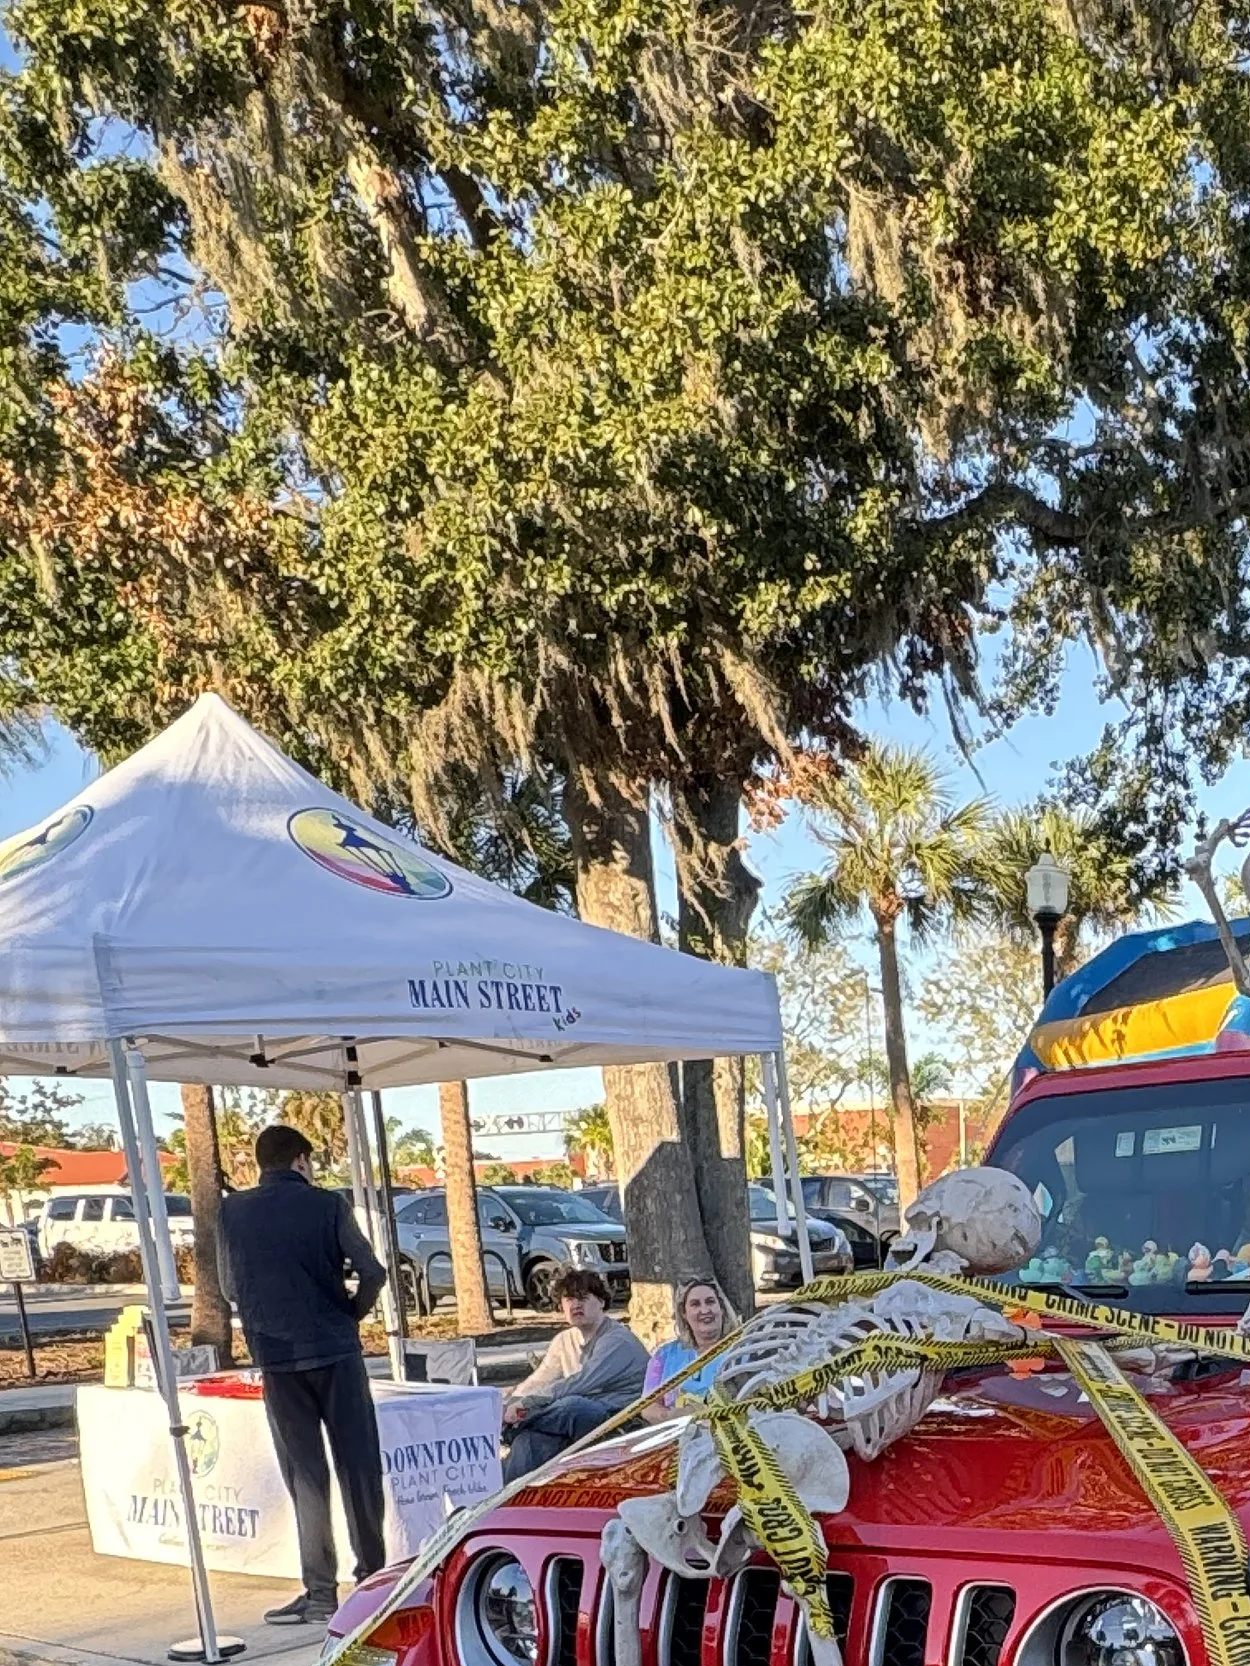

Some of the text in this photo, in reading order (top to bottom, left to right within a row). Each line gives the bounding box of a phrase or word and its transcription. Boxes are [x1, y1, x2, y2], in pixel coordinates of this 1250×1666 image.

[433, 960, 544, 980] PLANT CITY
[408, 979, 563, 1013] MAIN STREET
[1104, 1306, 1160, 1335] SCENE
[1177, 1322, 1199, 1343] DO
[1204, 1328, 1236, 1350] NOT
[391, 1462, 488, 1489] PLANT CITY
[204, 1484, 245, 1503] CITY
[199, 1503, 260, 1538] TREET
[1188, 1522, 1247, 1601] WARNING
